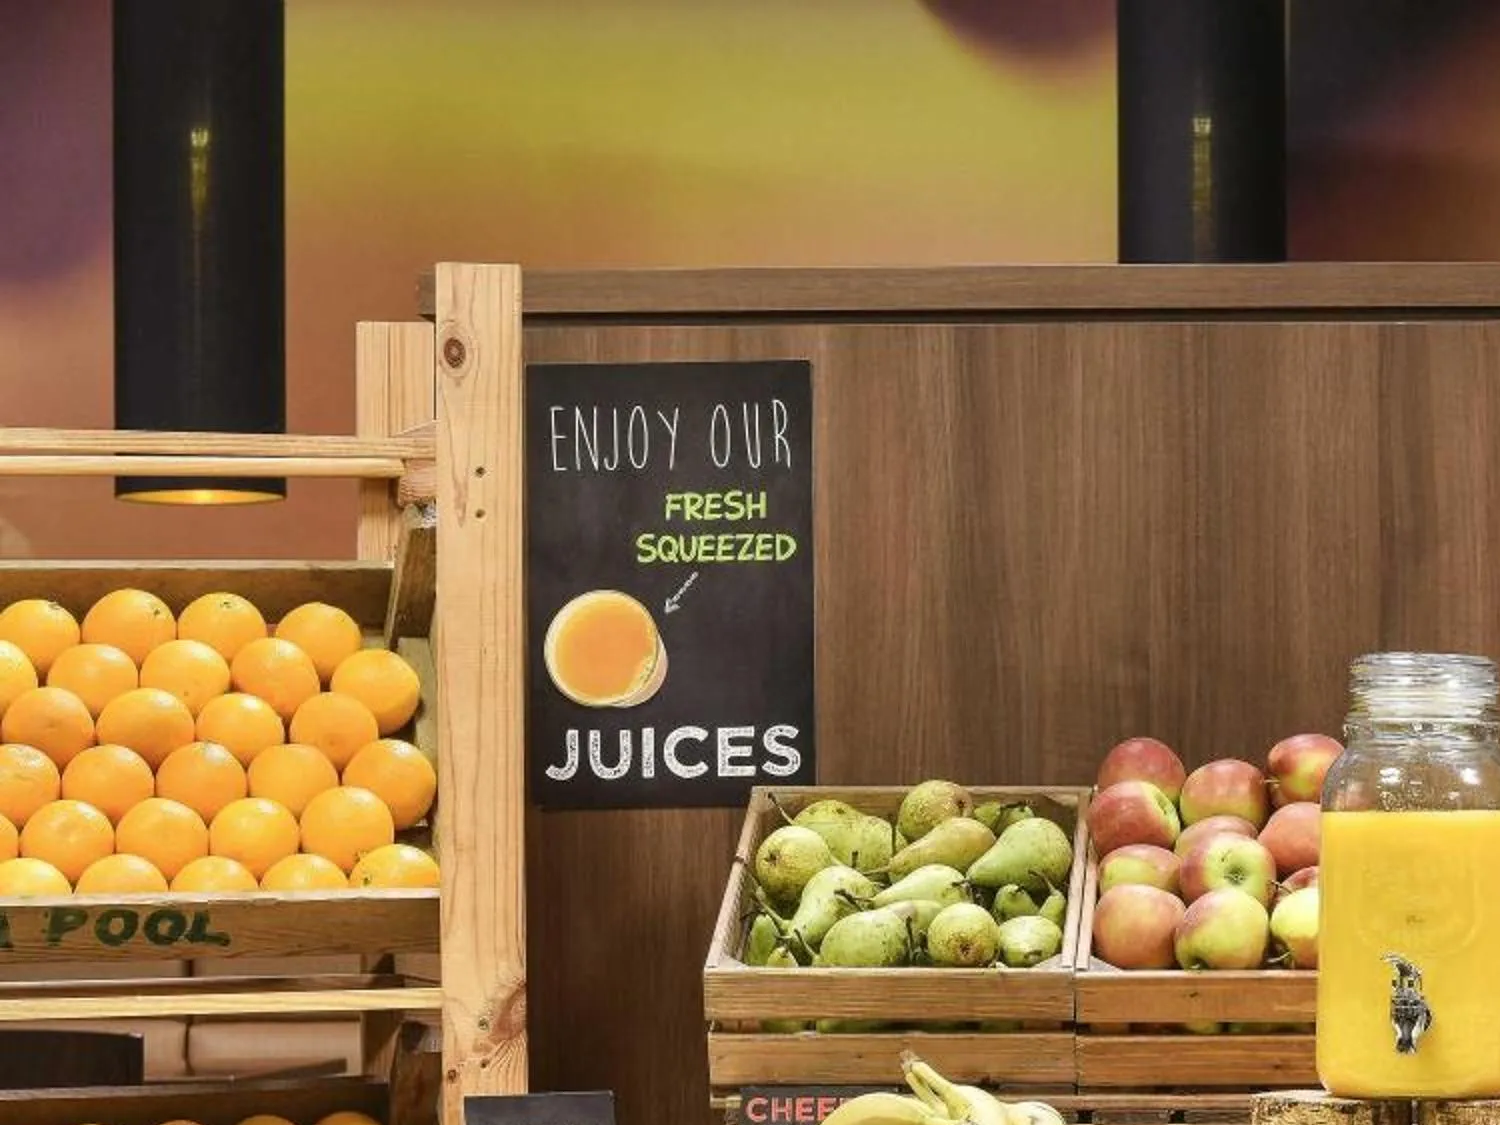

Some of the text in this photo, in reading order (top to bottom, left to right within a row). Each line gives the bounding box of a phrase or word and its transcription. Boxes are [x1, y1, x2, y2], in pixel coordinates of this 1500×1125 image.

[550, 399, 792, 472] ENJOY OUR
[664, 491, 768, 521] FRESH
[635, 531, 797, 564] SQUEEZED
[545, 724, 802, 781] JUICES
[44, 908, 231, 946] POOL
[746, 1097, 852, 1122] CHEE
